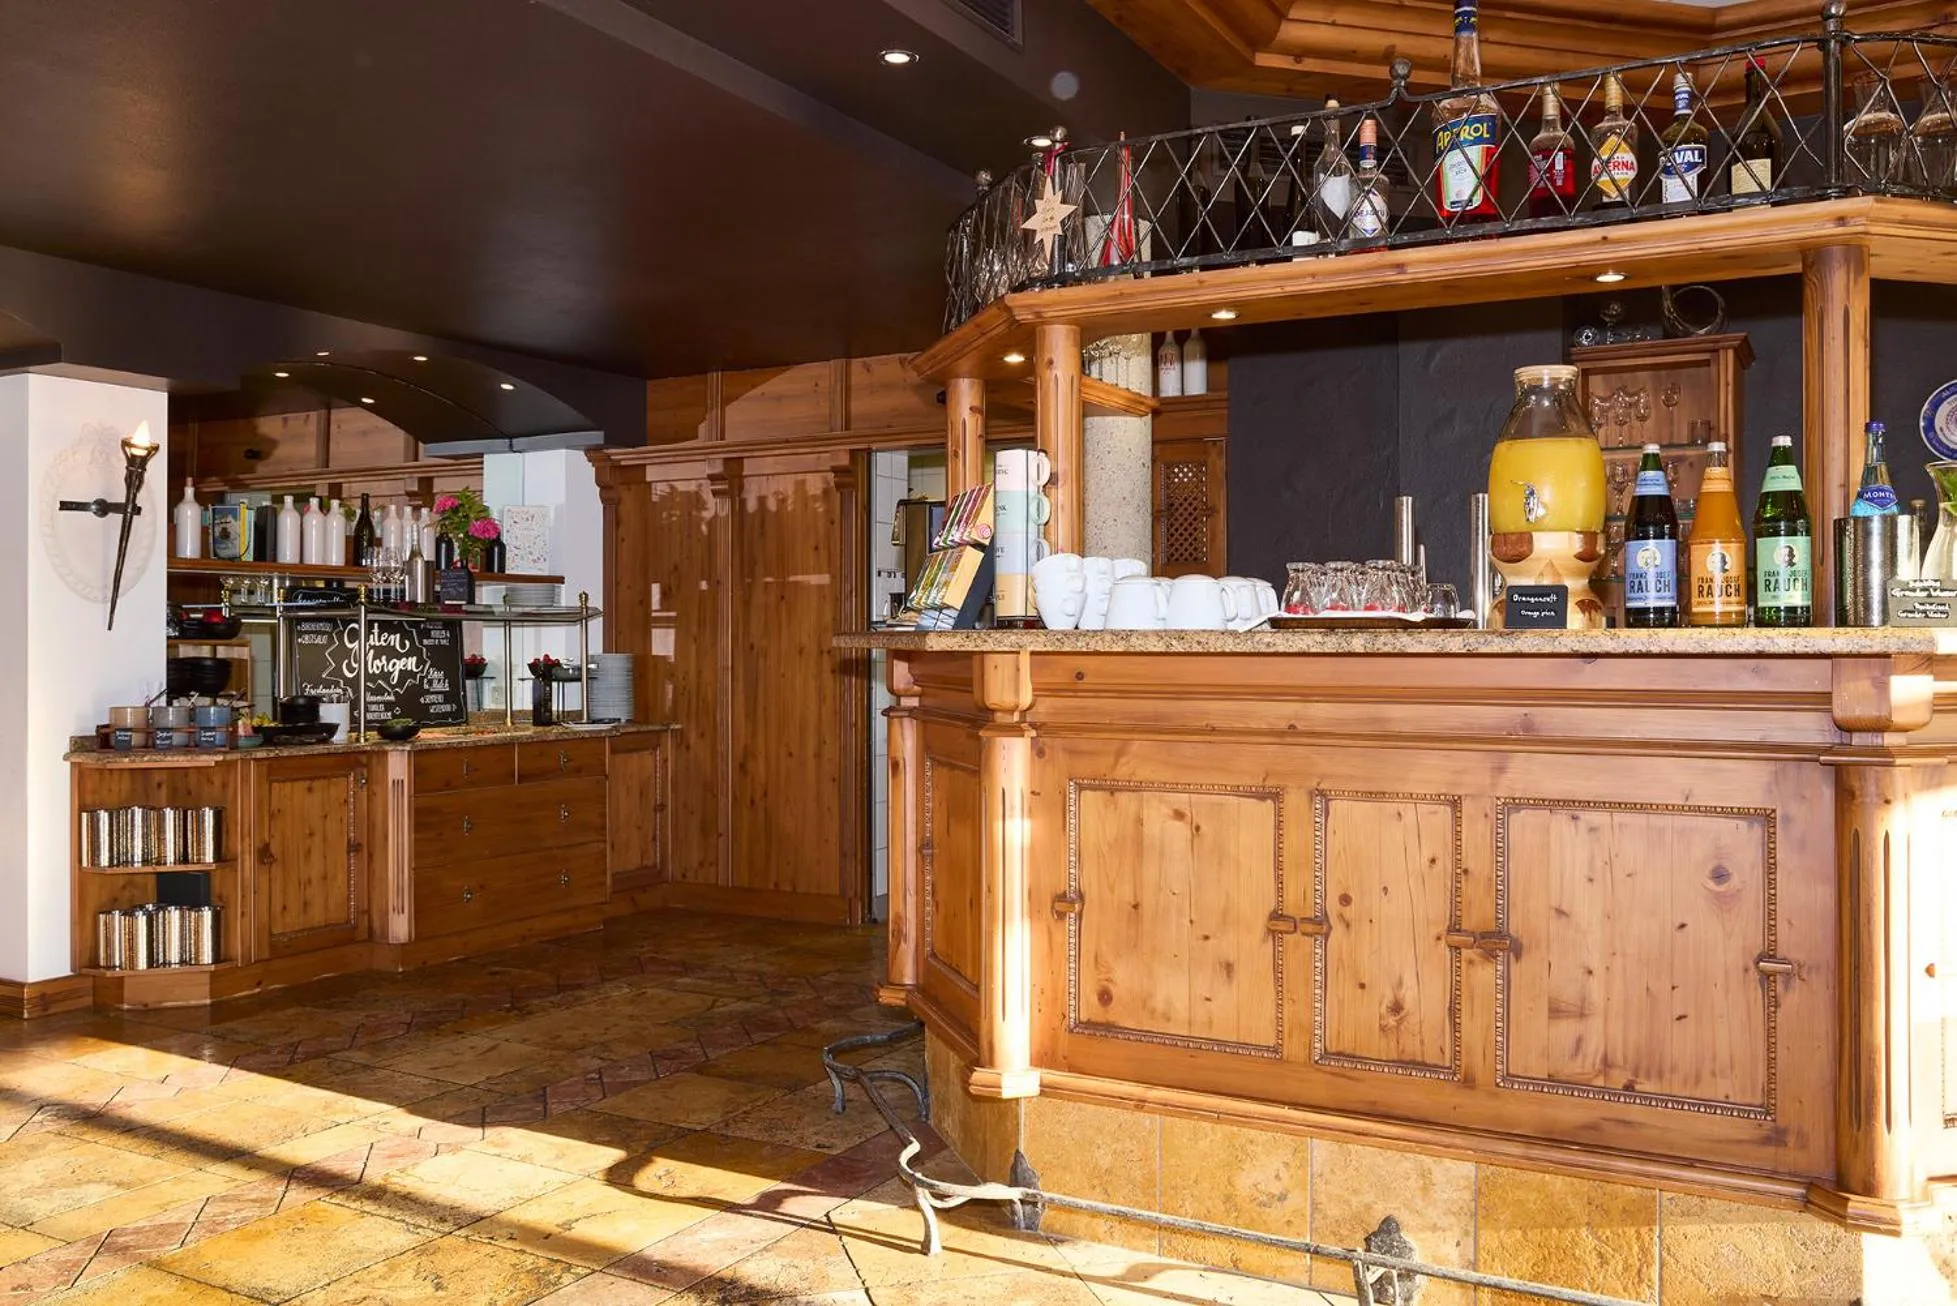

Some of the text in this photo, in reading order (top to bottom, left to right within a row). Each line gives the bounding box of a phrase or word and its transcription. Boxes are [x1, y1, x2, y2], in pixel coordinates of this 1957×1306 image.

[1629, 579, 1671, 594] RAUCH
[1698, 583, 1741, 598] RAUCH
[1764, 577, 1808, 592] RAUCH
[344, 622, 410, 654] Guten
